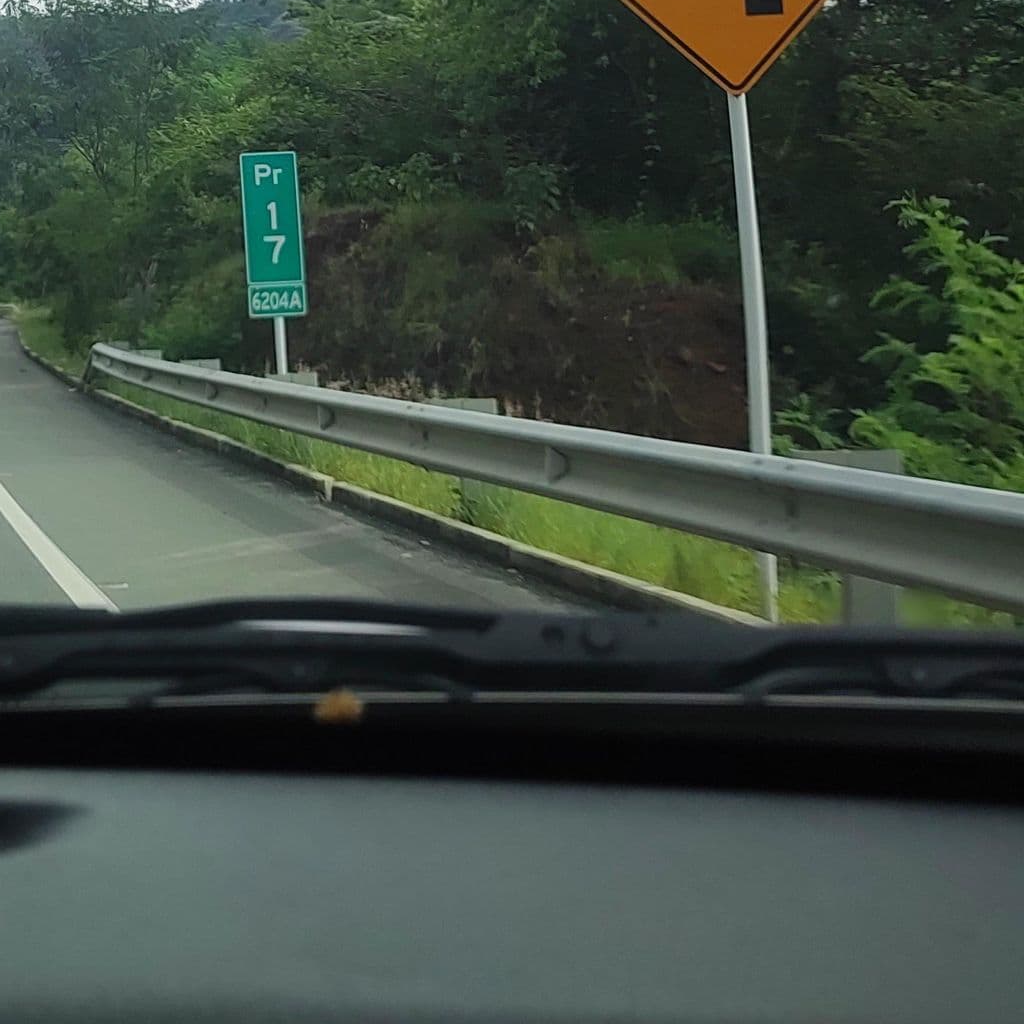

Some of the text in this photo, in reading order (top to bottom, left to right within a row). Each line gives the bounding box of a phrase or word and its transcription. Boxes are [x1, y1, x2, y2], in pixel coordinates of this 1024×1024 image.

[254, 164, 283, 186] Pr
[266, 201, 278, 230] 1
[263, 235, 286, 264] 7
[251, 290, 302, 311] 6204A
